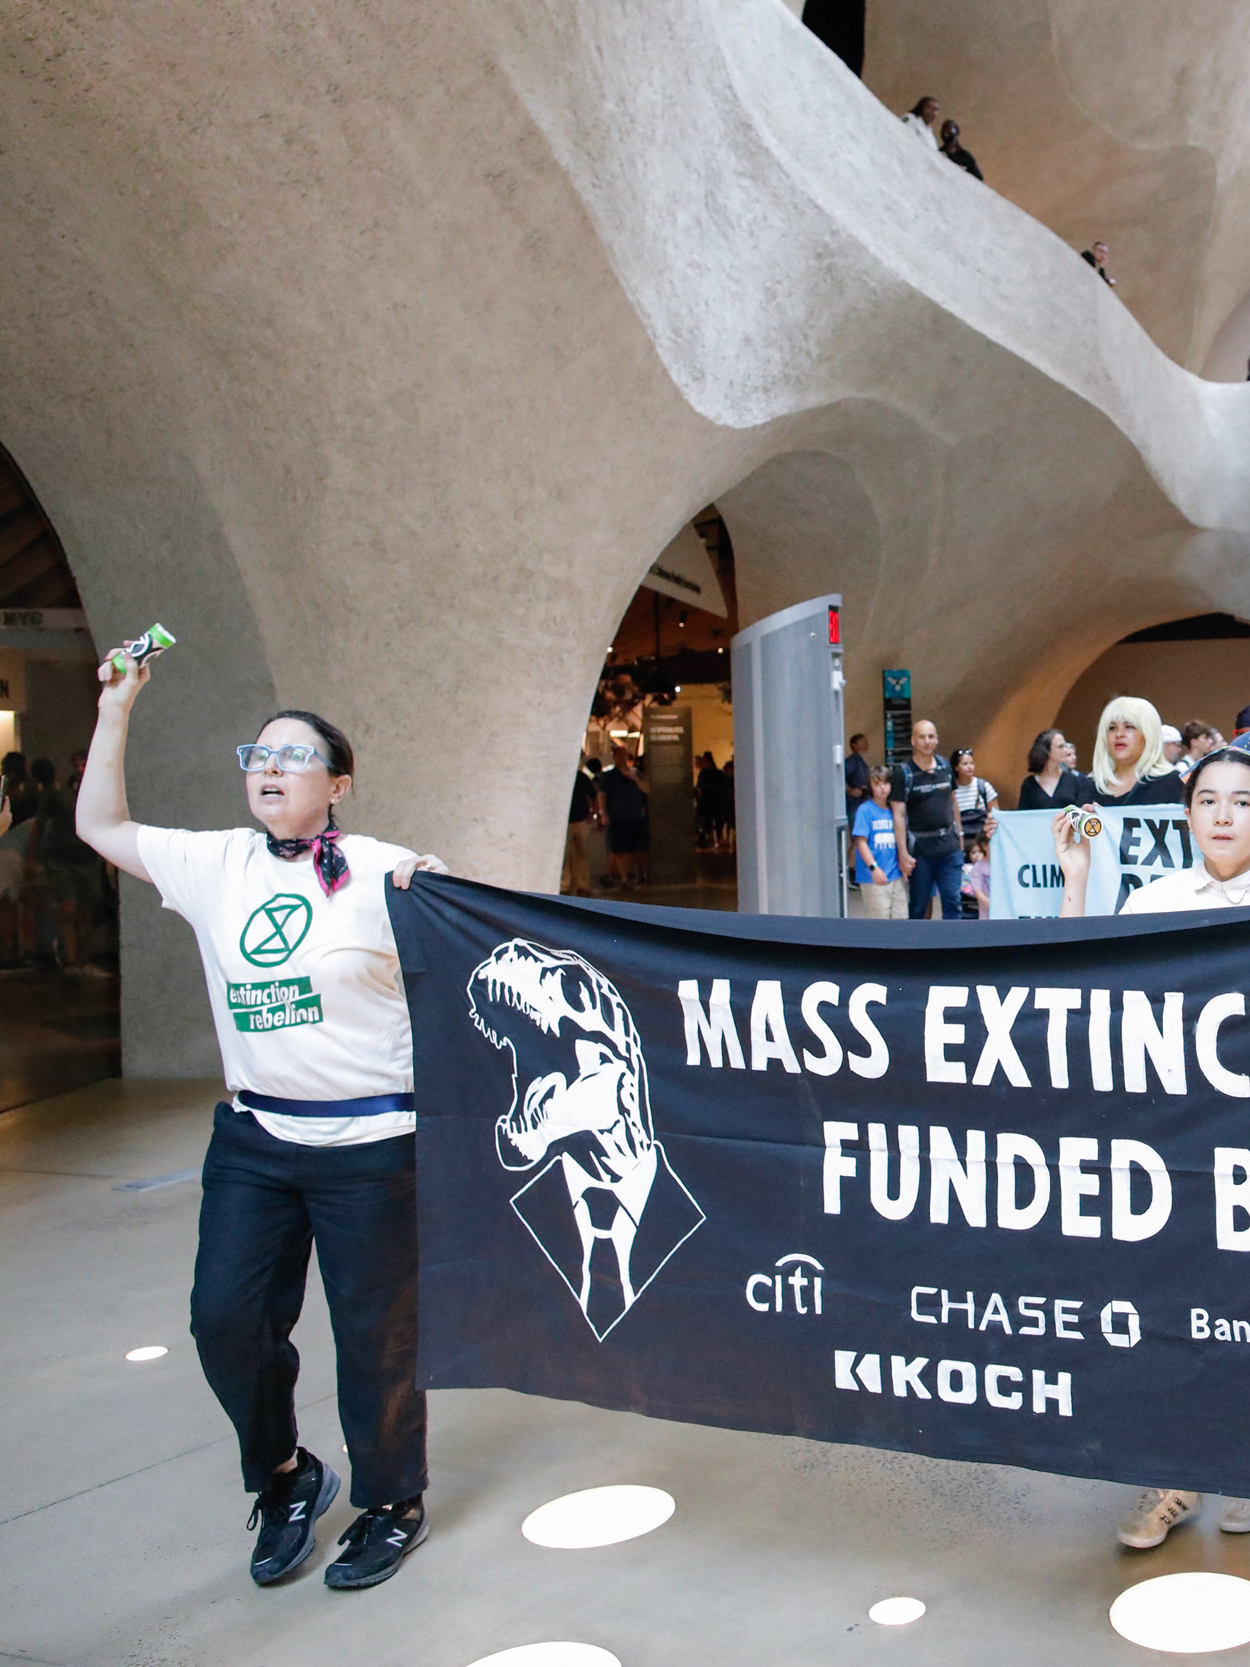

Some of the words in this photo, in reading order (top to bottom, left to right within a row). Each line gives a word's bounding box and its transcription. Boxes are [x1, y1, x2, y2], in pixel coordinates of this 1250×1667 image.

[1017, 864, 1065, 888] CLIM
[678, 979, 889, 1078] MASS
[823, 1121, 1172, 1241] FUNDED
[746, 1254, 824, 1314] citi
[911, 1286, 1085, 1339] CHASE
[891, 1355, 1073, 1417] KOCH
